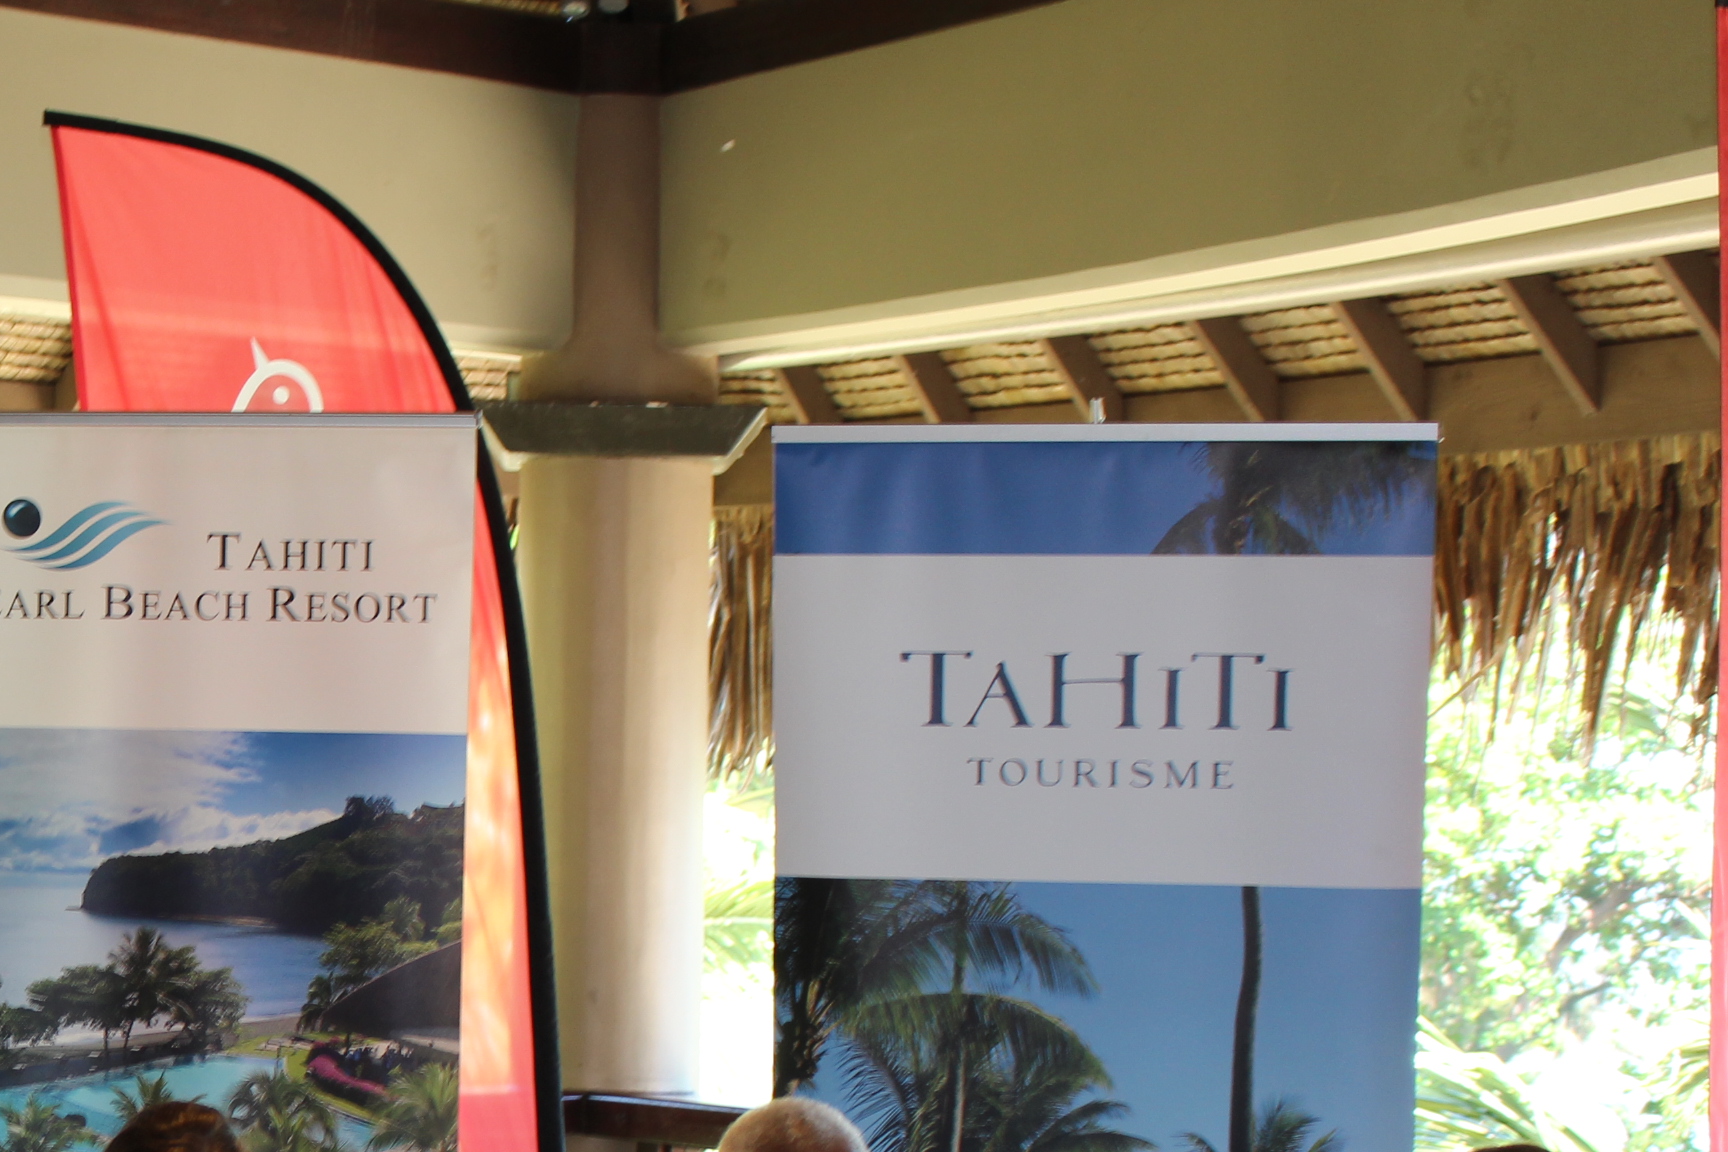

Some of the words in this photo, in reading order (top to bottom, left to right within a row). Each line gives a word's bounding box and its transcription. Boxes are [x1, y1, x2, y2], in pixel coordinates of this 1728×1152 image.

[206, 532, 376, 573] TAHITI
[100, 584, 250, 623] BEACH
[266, 587, 438, 624] RESORT
[899, 649, 1295, 732] TAHITI
[966, 756, 1235, 790] TOURISME
